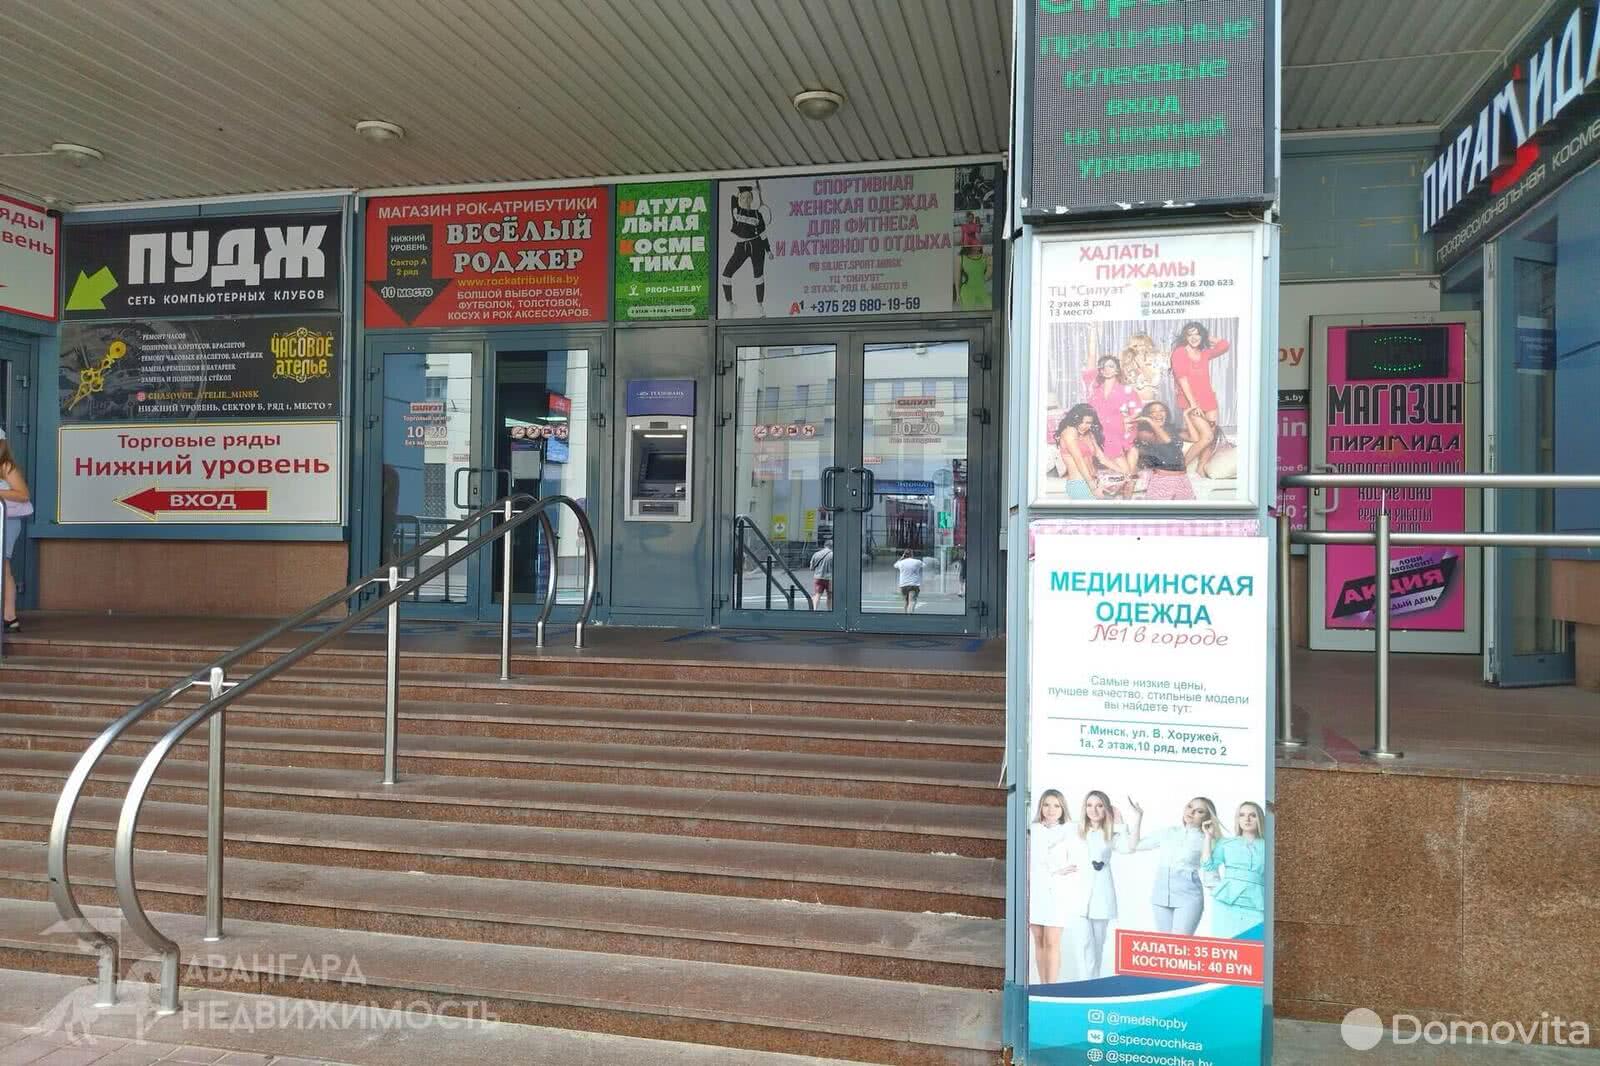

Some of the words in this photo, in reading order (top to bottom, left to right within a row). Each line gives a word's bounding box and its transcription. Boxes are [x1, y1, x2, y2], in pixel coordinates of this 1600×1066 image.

[1064, 57, 1229, 89] клеевые
[1106, 95, 1181, 116] вход
[1064, 129, 1099, 145] на
[1079, 151, 1200, 179] уровень
[814, 175, 914, 196] СПОРТИВНАЯ
[379, 202, 451, 218] МАГАЗИН
[456, 198, 597, 216] РОК-АТРИБУТИКИ
[789, 197, 864, 217] ЖЕНСКАЯ
[867, 193, 939, 214] ОДЕЖДА
[447, 213, 592, 244] ВЕСЁЛЫЙ
[622, 214, 699, 233] ЛЬНАЯ
[807, 218, 840, 237] ДЛЯ
[845, 214, 919, 234] ФИТНЕСА
[391, 234, 425, 243] НИЖНИЙ
[775, 240, 786, 256] И
[791, 237, 878, 256] АКТИВНОГО
[884, 232, 952, 253] ОТДЫХА
[127, 226, 327, 287] ПУДЖ
[391, 244, 428, 252] УРОВЕНЬ
[1080, 244, 1159, 262] ХАЛАТЫ
[454, 249, 584, 274] РОДЖЕР
[630, 255, 694, 272] ТИКА
[1096, 262, 1195, 280] ПИЖАМЫ
[128, 296, 155, 306] СЕТЬ
[164, 292, 265, 305] КОМПЬЮТЕРНЫХ
[274, 290, 325, 301] КЛУБОВ
[381, 287, 396, 298] 10
[504, 289, 542, 298] ВЫБОР
[545, 288, 582, 297] ОБУВИ,
[645, 285, 702, 294] PROD-LIFE.BY
[1048, 286, 1067, 298] ТЦ
[458, 300, 515, 309] ФУТБОЛОК,
[518, 298, 581, 308] ТОЛСТОВОК,
[810, 299, 839, 313] +375
[842, 299, 858, 312] 29
[860, 297, 921, 311] 680-19-59
[1049, 300, 1054, 309] 2
[1092, 300, 1111, 309] ряд
[1050, 308, 1060, 317] 13
[1063, 309, 1093, 317] место
[448, 312, 480, 320] КОСУХ
[483, 311, 489, 319] И
[493, 310, 512, 319] РОК
[271, 336, 334, 359] ЧАСОВОЕ
[138, 403, 178, 412] НИЖНИЙ
[222, 403, 256, 411] СЕКТОР
[267, 403, 284, 411] РЯД
[294, 402, 325, 410] МЕСТО
[1327, 383, 1464, 426] МАГАЗИН
[117, 434, 216, 451] Торговые
[223, 433, 281, 449] ряды
[1328, 433, 1461, 453] ПИРАМИДА
[75, 455, 192, 476] Нижний
[201, 457, 330, 479] уровень
[169, 493, 236, 509] ВХОД
[1051, 571, 1253, 597] МЕДИЦИНСКАЯ
[1414, 596, 1438, 607] ДЕНЬ
[1096, 601, 1212, 628] ОДЕЖДА
[1088, 623, 1126, 643] №1
[1134, 625, 1147, 643] в
[1152, 628, 1229, 648] городе
[1090, 675, 1129, 687] Самые
[1132, 678, 1170, 689] низкие
[1174, 681, 1207, 692] цены,
[1048, 687, 1089, 699] лучшее
[1091, 688, 1142, 701] качество,
[1147, 691, 1202, 703] стильные
[1205, 694, 1249, 706] модели
[1104, 701, 1120, 710] вы
[1122, 700, 1168, 713] найдете
[1132, 728, 1149, 739] ул.
[1152, 728, 1164, 739] В.
[1167, 730, 1222, 744] Хоружей,
[1080, 738, 1094, 749] 1а,
[1098, 739, 1104, 748] 2
[1153, 743, 1178, 754] ряд,
[1181, 746, 1216, 755] место
[1220, 746, 1227, 755] 2
[1131, 941, 1190, 957] ХАЛАТЫ:
[1194, 947, 1208, 958] 35
[1211, 948, 1238, 960] BYN
[1132, 956, 1204, 972] КОСТЮМЫ:
[1208, 963, 1222, 974] 40
[1226, 964, 1252, 976] BYN
[1107, 1011, 1188, 1031] @medshopby
[1106, 1032, 1203, 1051] @specovochkaa
[1106, 1051, 1213, 1066] @specovochkaby
